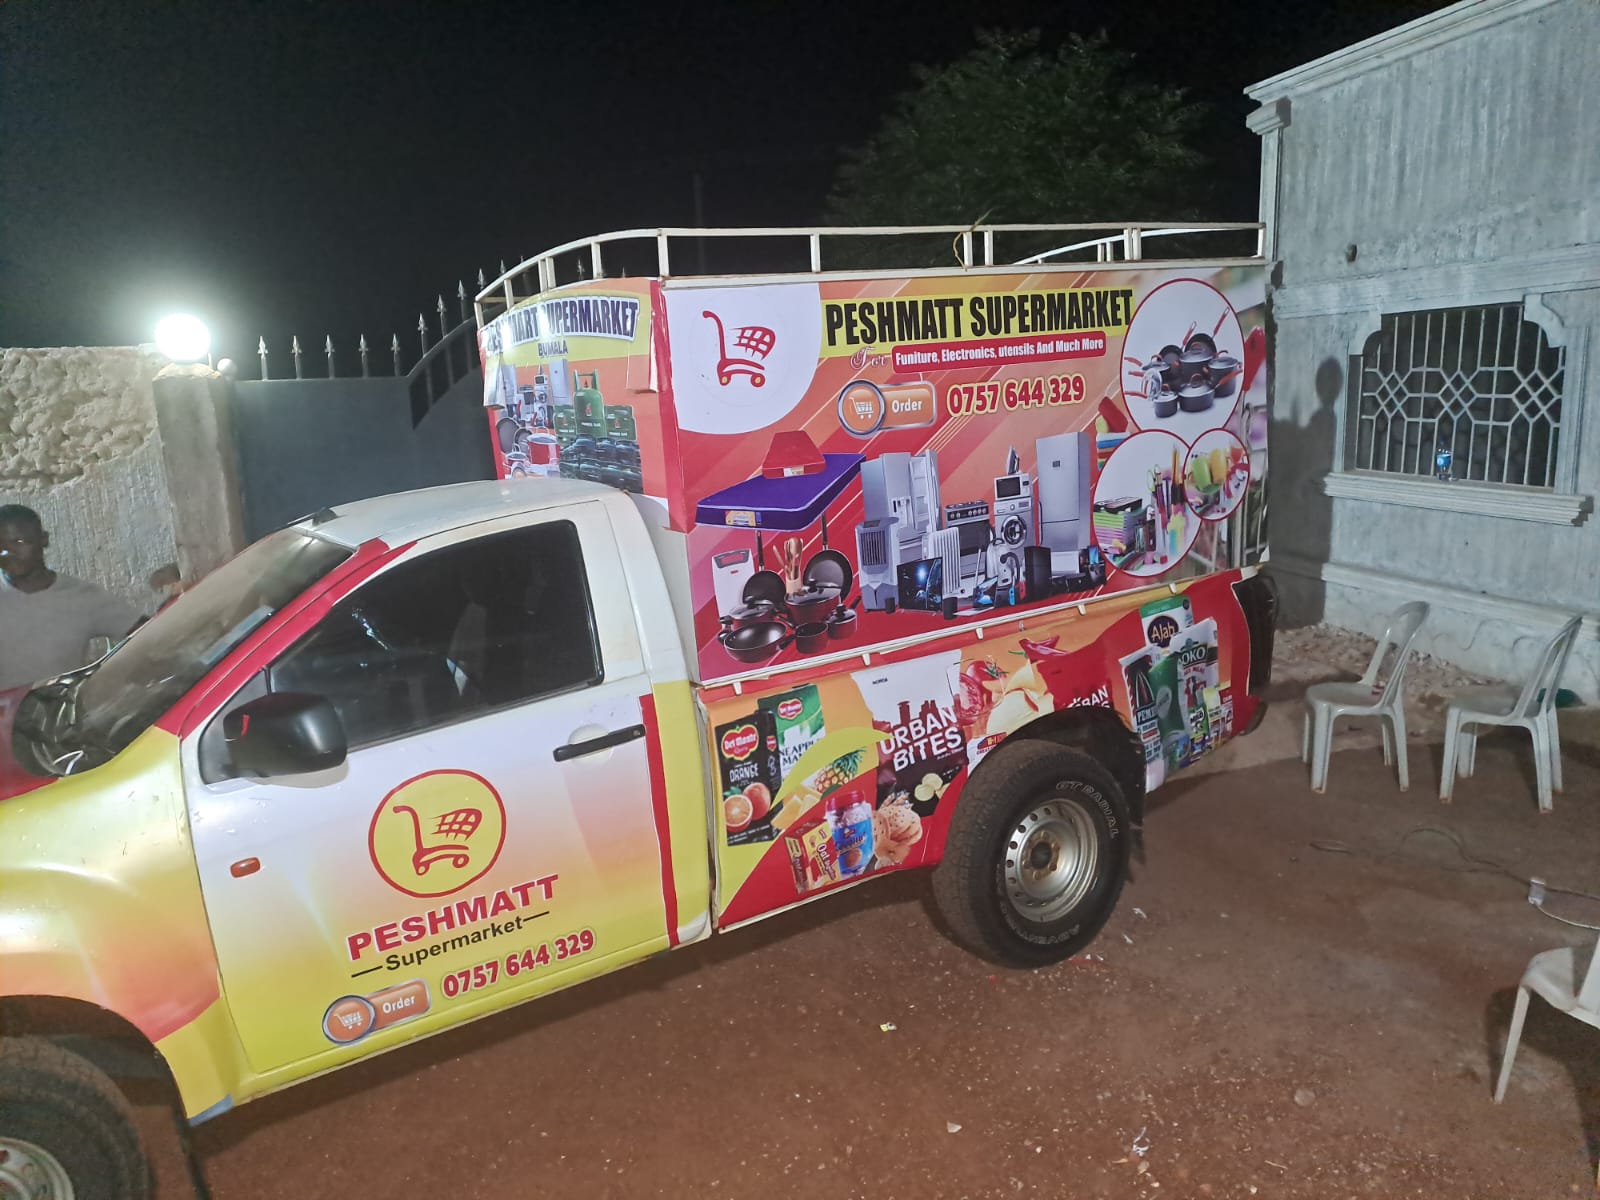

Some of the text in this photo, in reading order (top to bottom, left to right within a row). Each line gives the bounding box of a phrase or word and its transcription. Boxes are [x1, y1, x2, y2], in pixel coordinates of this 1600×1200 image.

[825, 289, 1133, 346] PESHMATT SUPERMARKET
[850, 338, 1104, 370] For Funiture, Electronics, utensils And Much More
[891, 398, 923, 414] Order
[948, 374, 1085, 415] 0757 644 329
[880, 705, 958, 755] URBAN
[893, 726, 962, 772] BITES
[729, 763, 759, 783] ORANGE
[346, 874, 559, 961] PESHMATT
[385, 915, 524, 972] Supermarket
[442, 929, 594, 998] 0757 644 329
[382, 995, 416, 1015] Order
